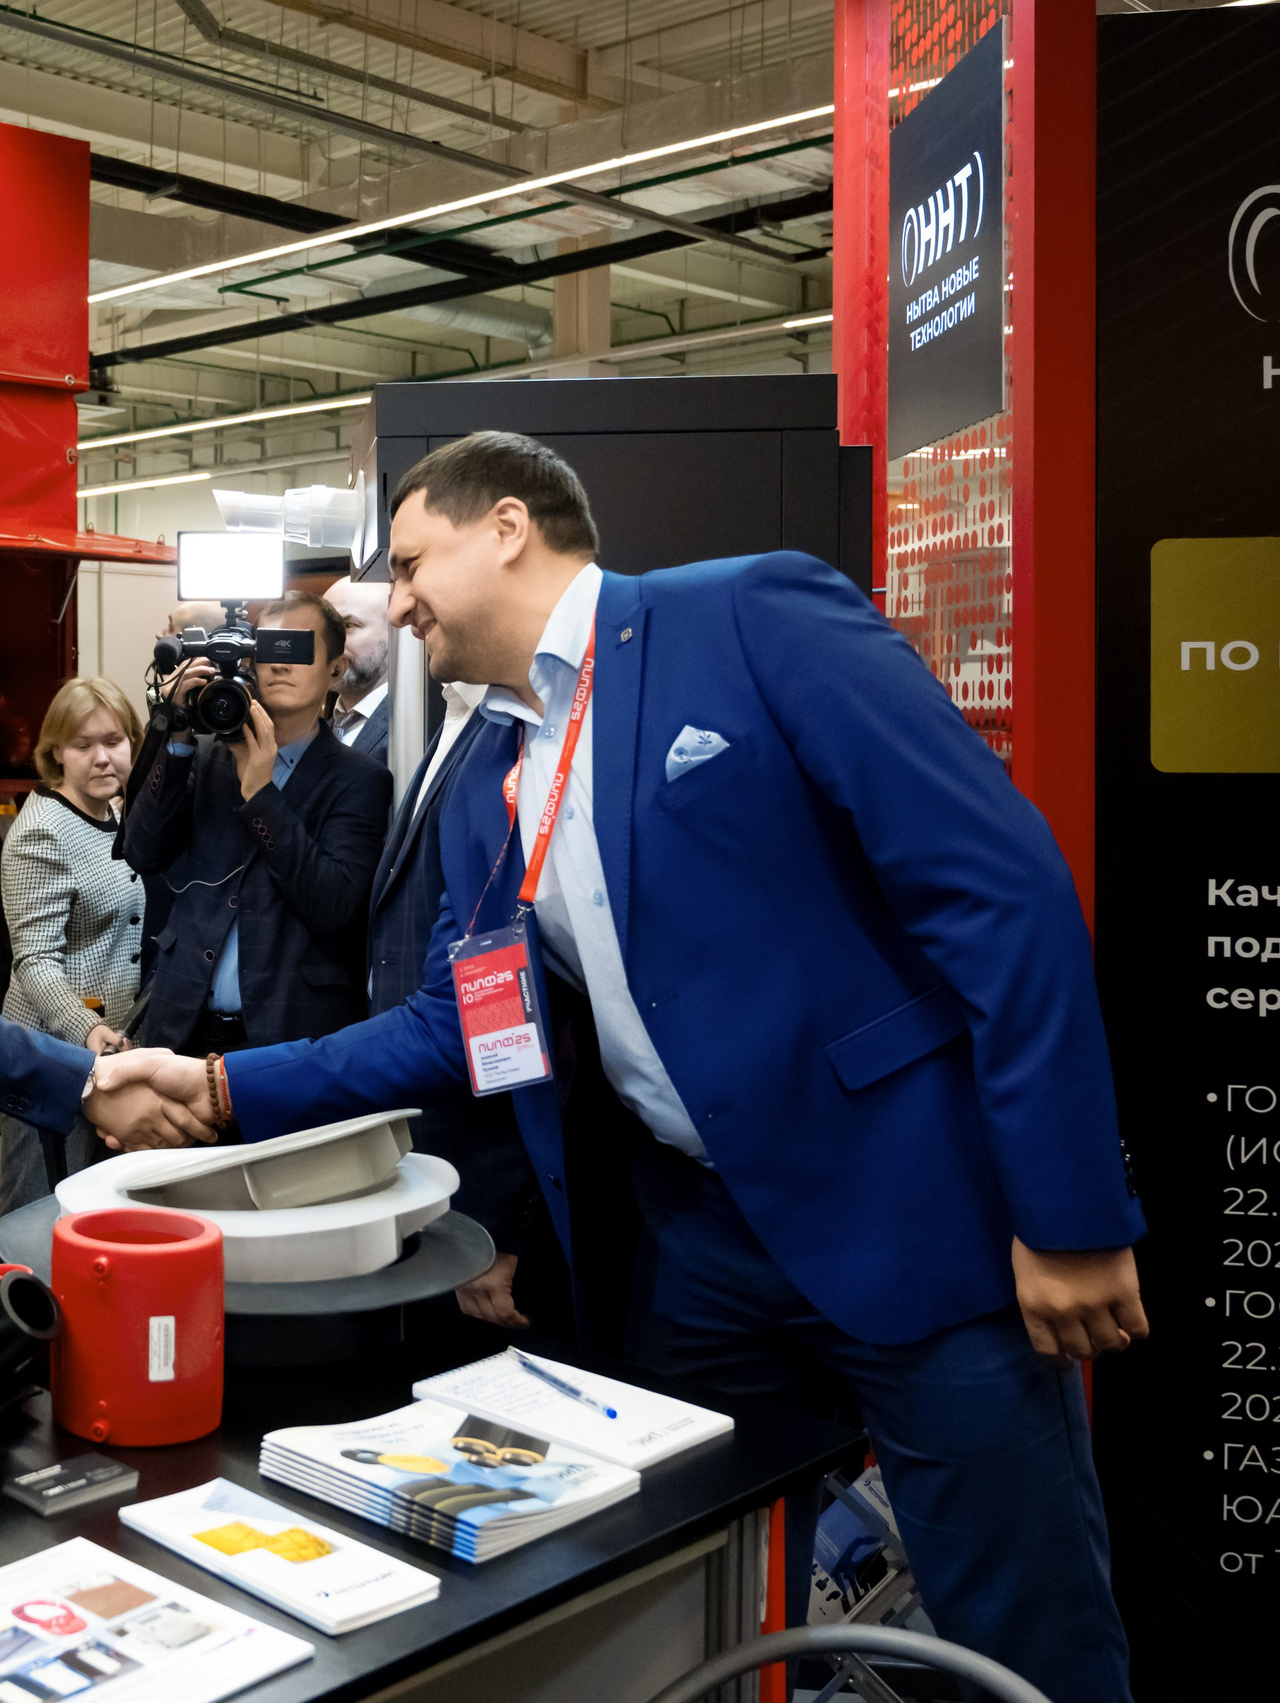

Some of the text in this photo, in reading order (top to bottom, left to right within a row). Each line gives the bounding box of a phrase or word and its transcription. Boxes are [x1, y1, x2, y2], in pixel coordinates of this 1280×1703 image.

[906, 256, 980, 325] НЫТВА НОВЫЕ
[909, 291, 976, 352] ТЕХНОЛОГИИ
[1181, 640, 1259, 671] по
[1206, 987, 1280, 1017] сер
[1220, 1552, 1264, 1574] от
